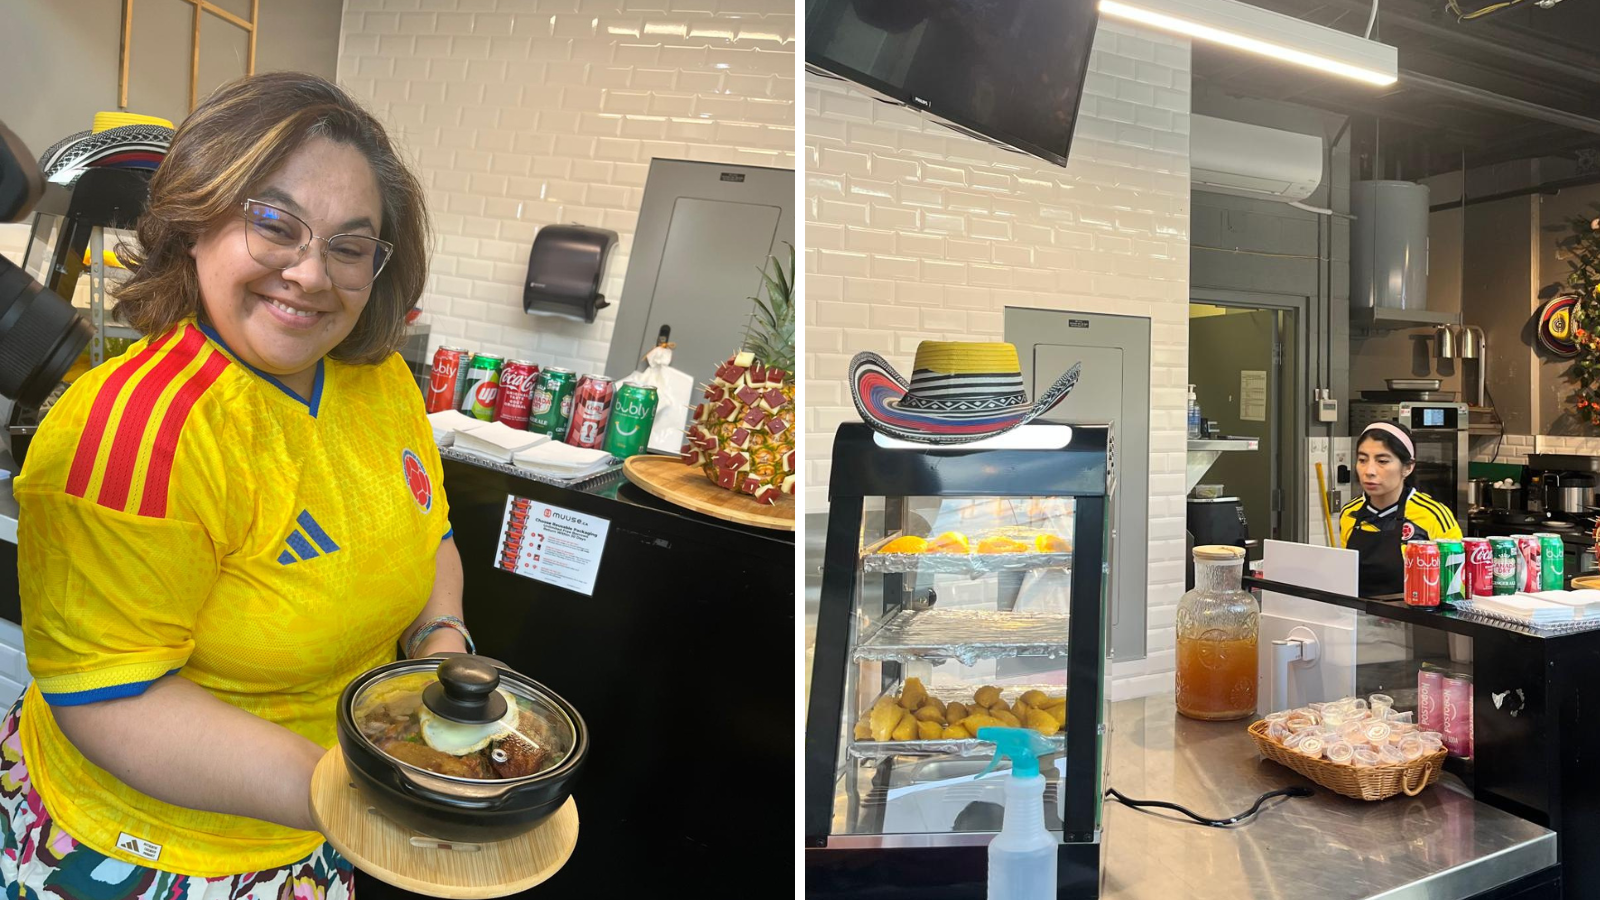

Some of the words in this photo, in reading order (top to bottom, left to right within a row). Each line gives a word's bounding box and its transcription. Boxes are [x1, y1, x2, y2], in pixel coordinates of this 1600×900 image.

[614, 398, 649, 420] bubly
[535, 517, 552, 526] Choose
[552, 521, 573, 531] Reusable
[573, 527, 598, 538] Packaging
[1545, 548, 1564, 558] bub
[1416, 556, 1440, 567] bubl
